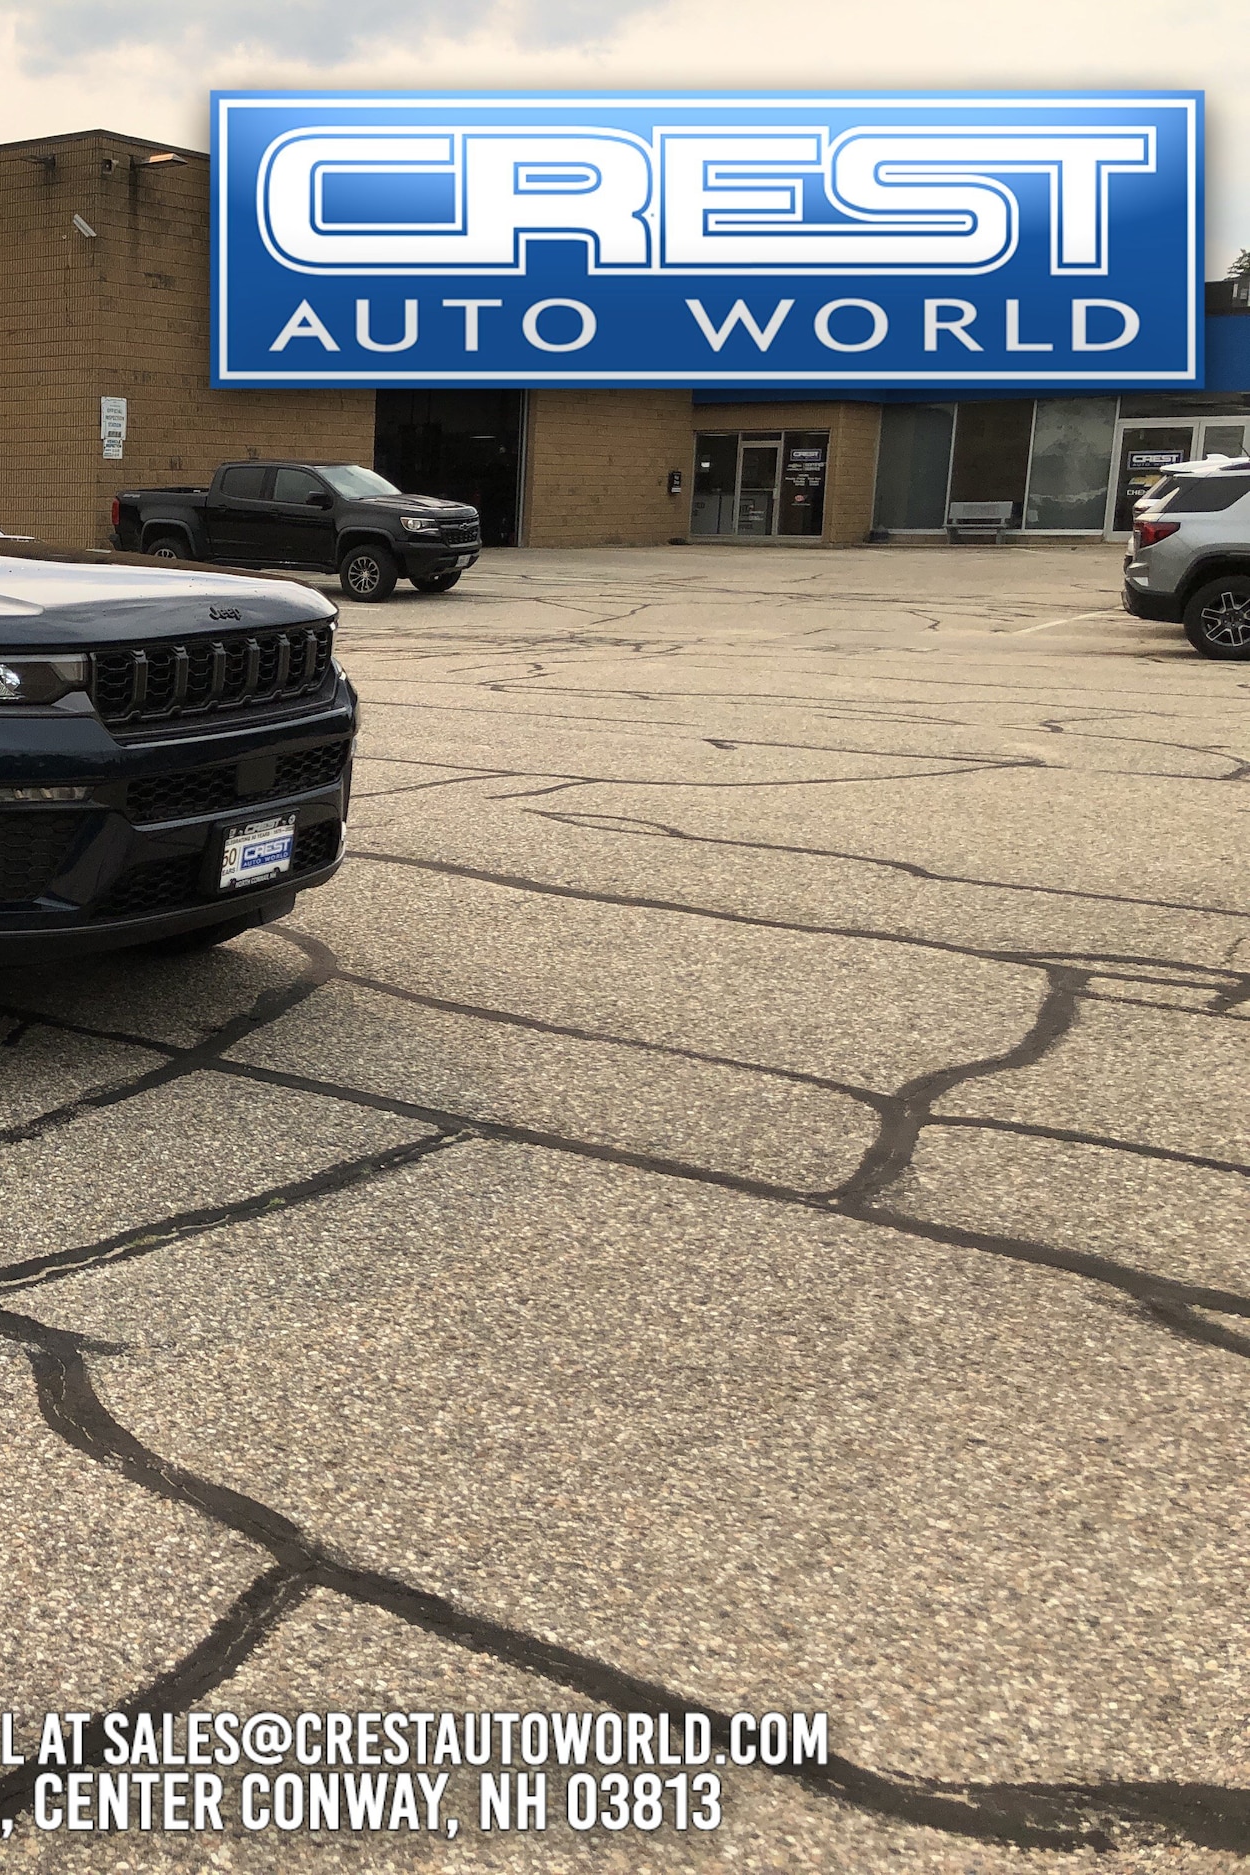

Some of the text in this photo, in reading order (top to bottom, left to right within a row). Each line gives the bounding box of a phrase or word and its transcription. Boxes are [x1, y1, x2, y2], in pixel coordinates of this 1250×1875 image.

[209, 606, 243, 621] Jeep
[244, 838, 290, 860] CREST
[243, 852, 288, 867] AUTO WORLD
